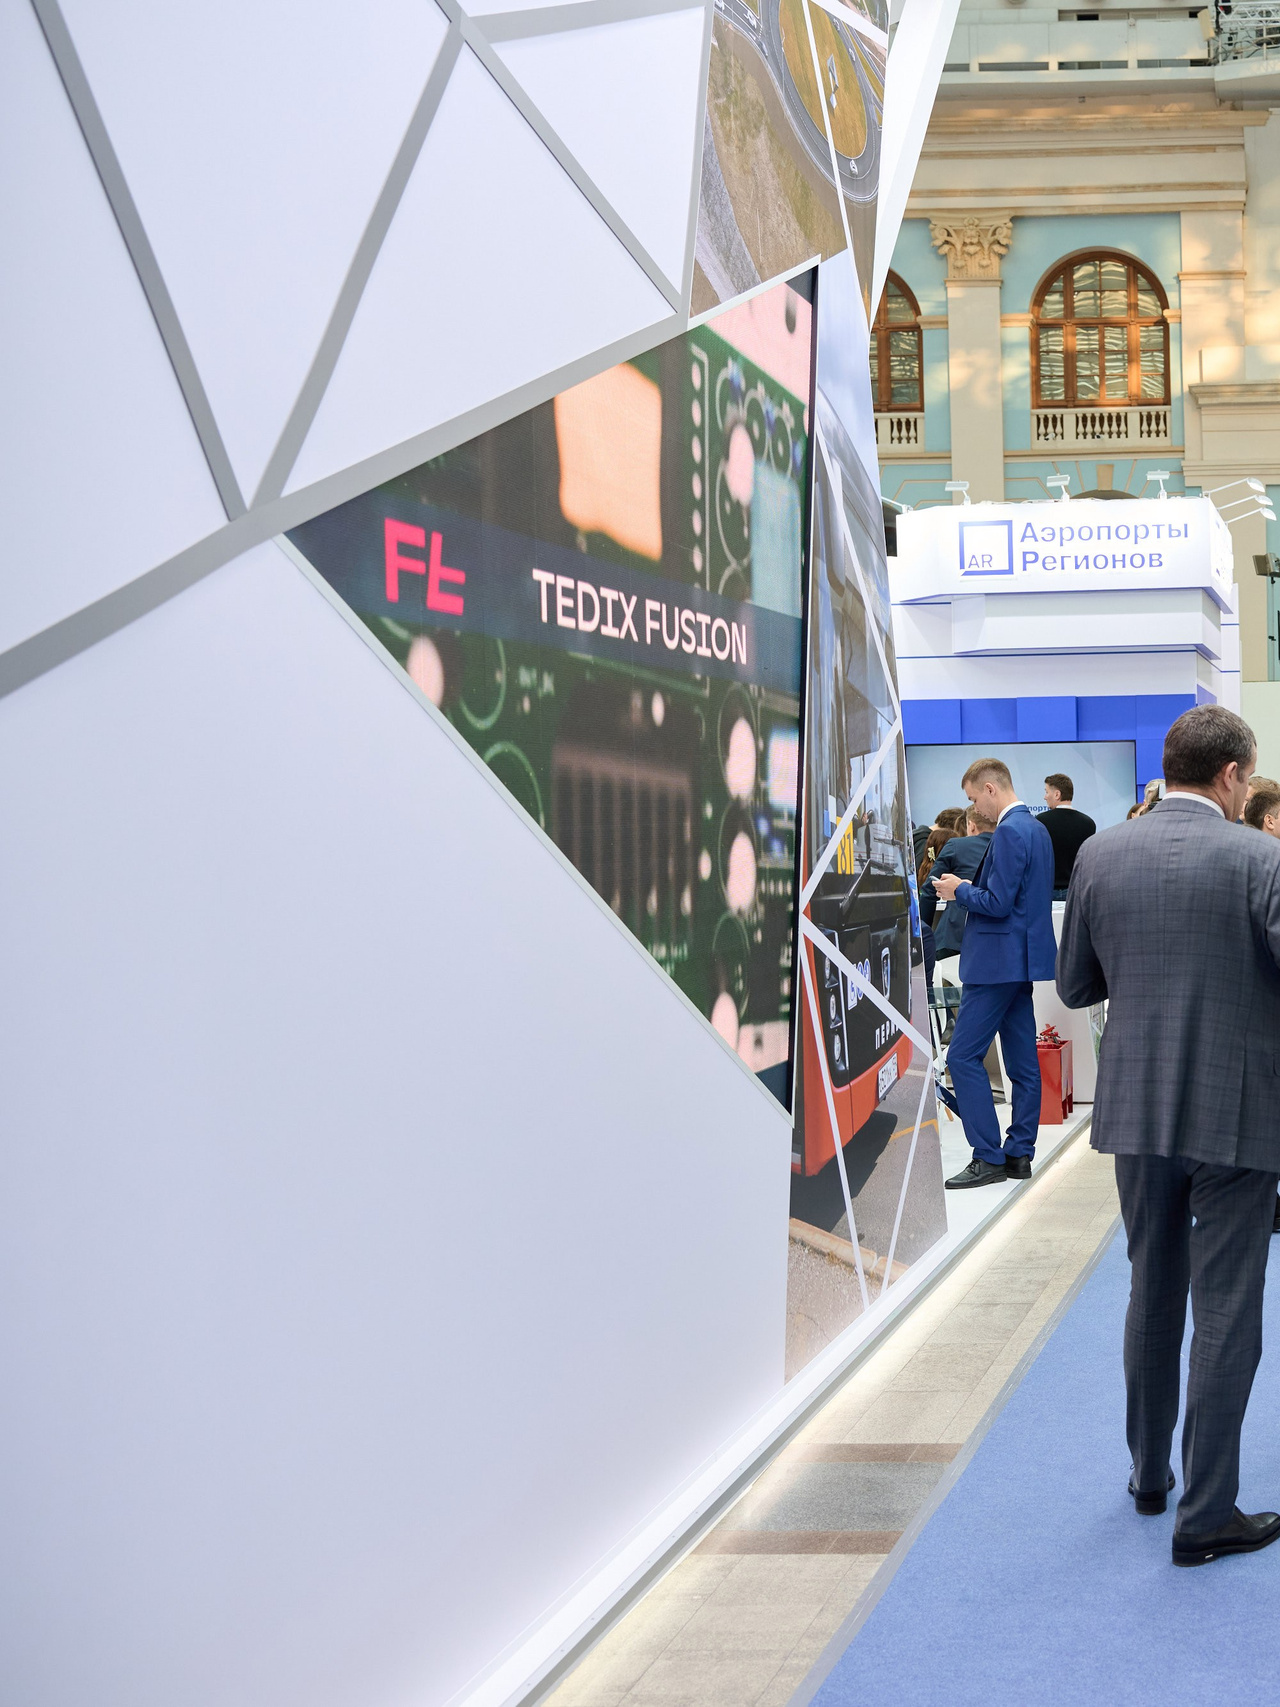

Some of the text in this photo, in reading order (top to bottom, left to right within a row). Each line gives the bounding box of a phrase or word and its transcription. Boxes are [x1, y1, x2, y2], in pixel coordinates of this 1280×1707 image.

[1020, 521, 1189, 547] Аэропорты
[968, 554, 993, 568] AR
[1022, 551, 1163, 571] Регионов
[532, 568, 747, 665] TEDIX FUSION
